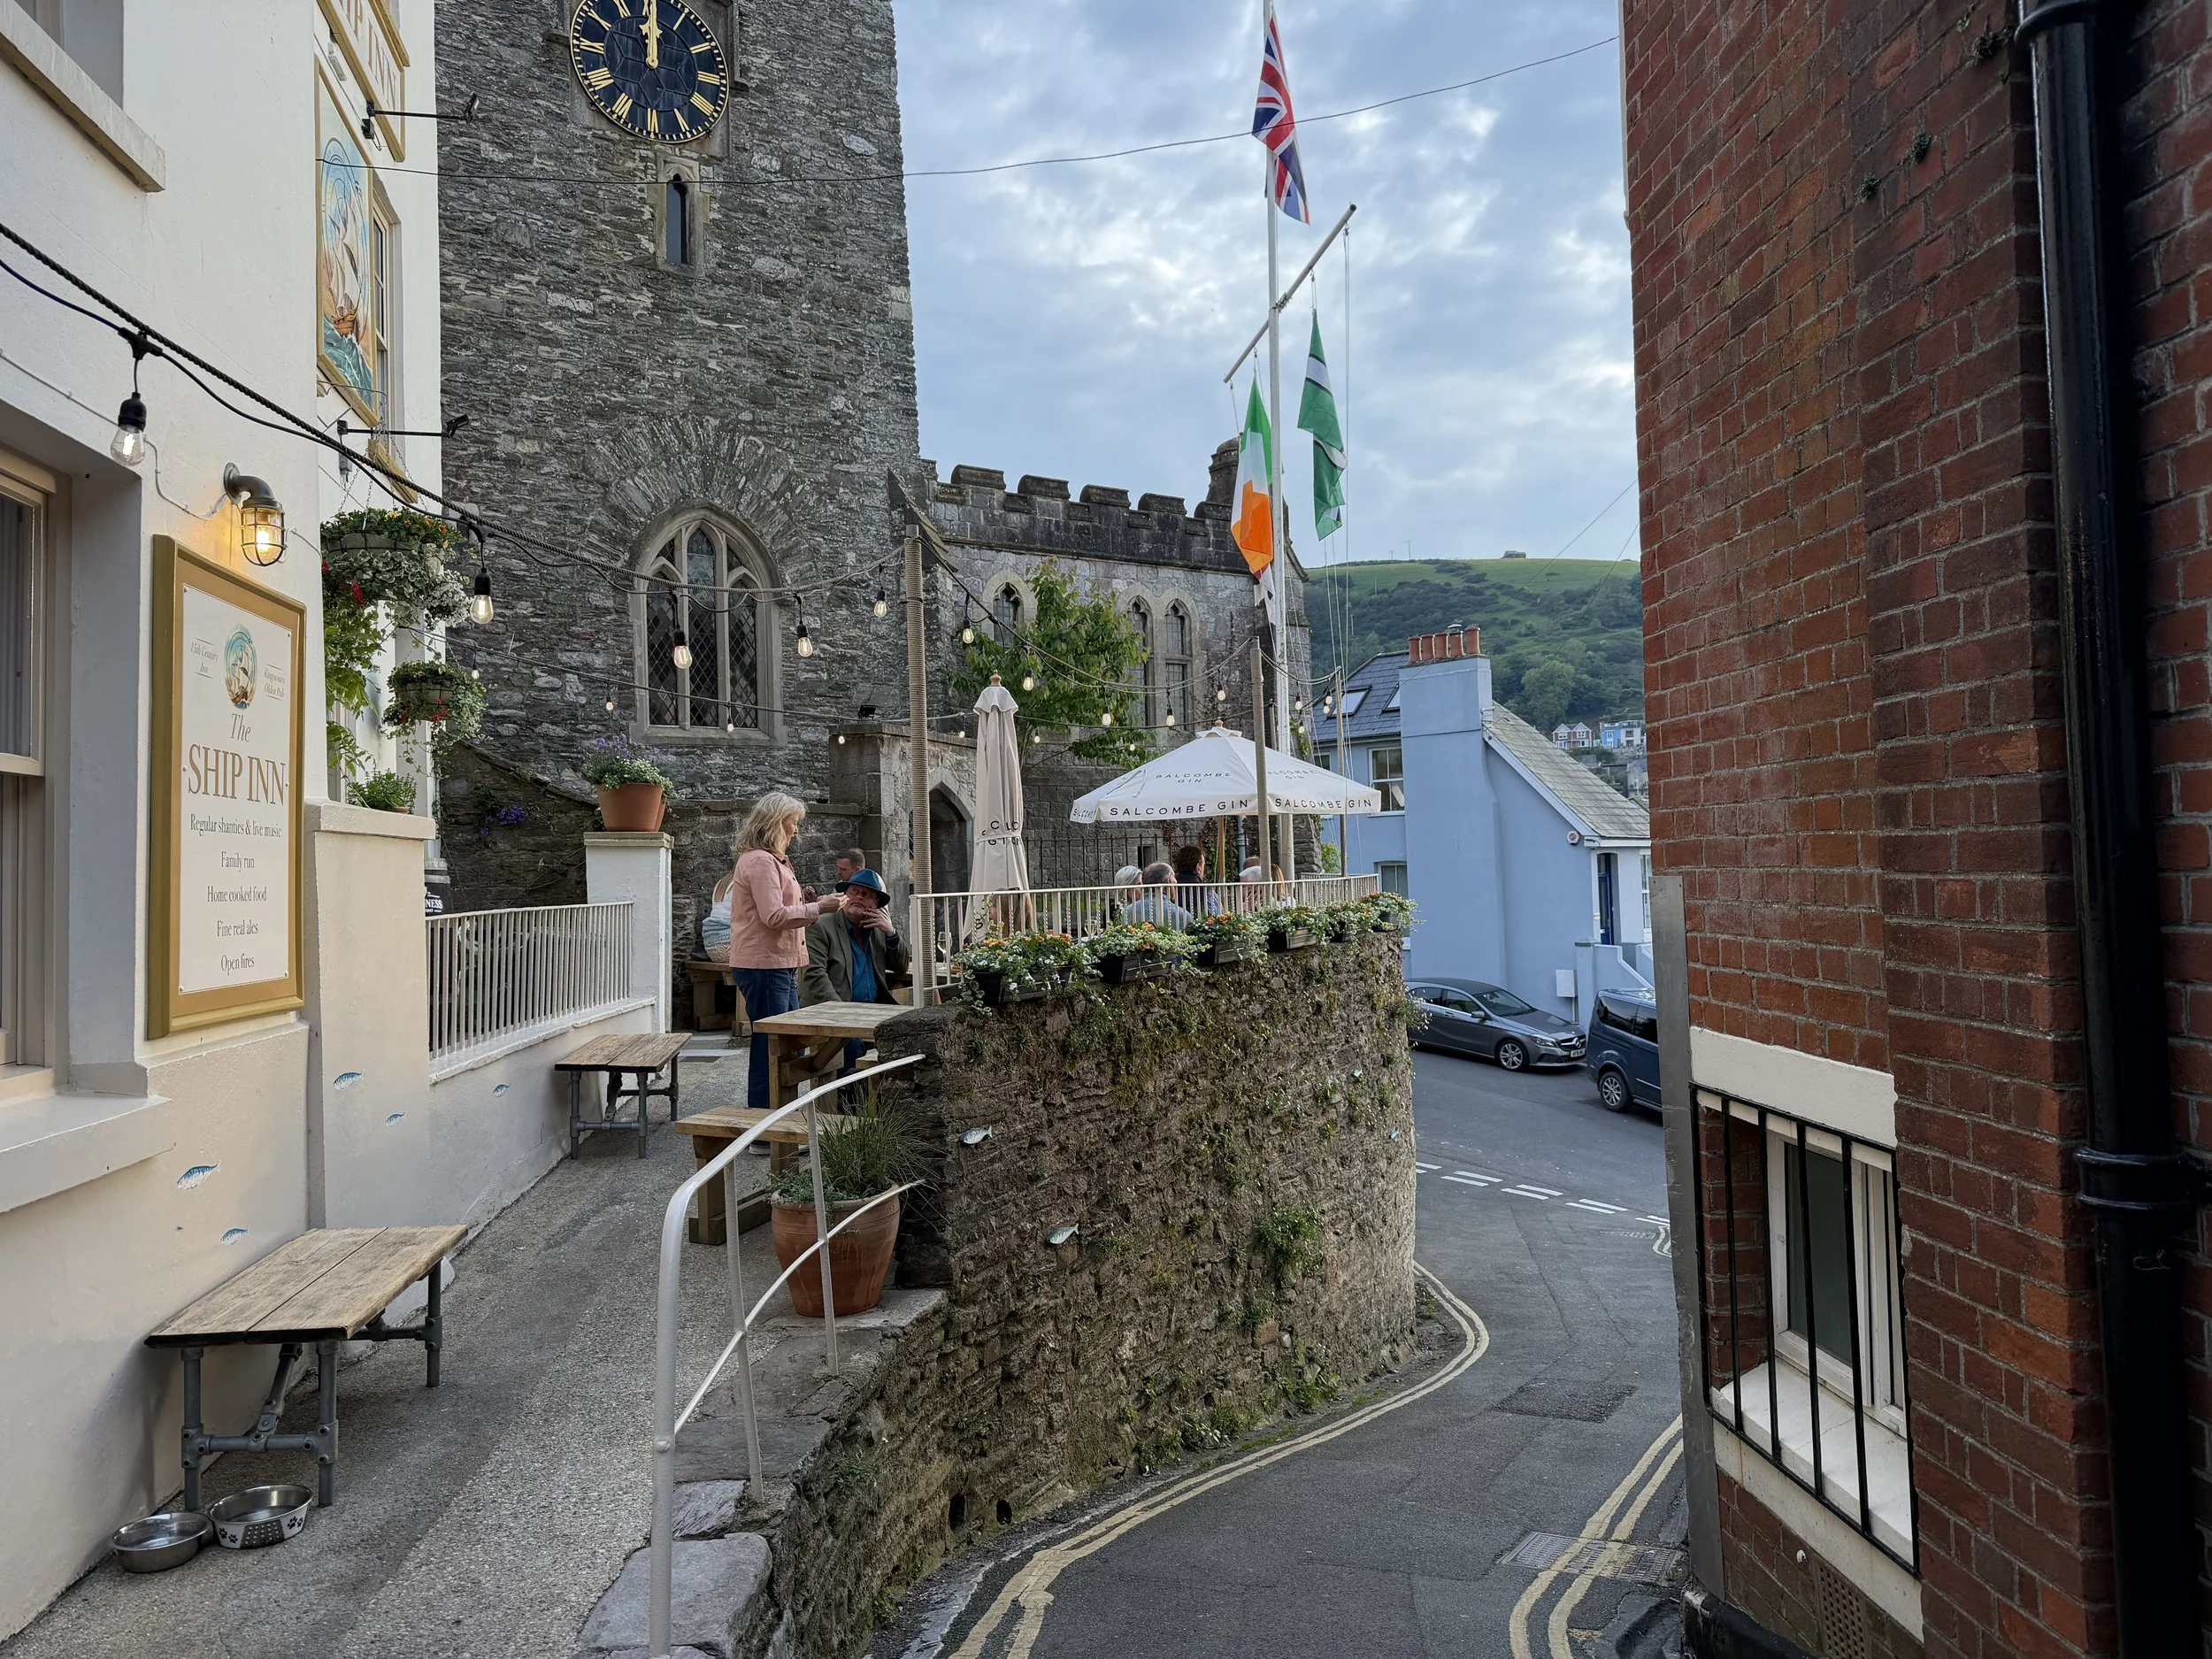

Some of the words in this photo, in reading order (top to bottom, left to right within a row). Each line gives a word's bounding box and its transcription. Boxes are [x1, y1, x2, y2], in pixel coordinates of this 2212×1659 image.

[368, 18, 396, 111] INN
[230, 713, 251, 742] The
[188, 743, 243, 799] SHIP
[247, 756, 286, 806] INN
[1110, 803, 1206, 816] SALCOMBE
[1217, 799, 1248, 810] GIN
[1275, 798, 1341, 809] SALCOMBE
[1348, 799, 1371, 809] GIN
[190, 813, 218, 837] Regular
[218, 817, 245, 835] shanties
[245, 819, 251, 835] &
[252, 820, 264, 836] live
[264, 823, 282, 838] music
[221, 851, 242, 873] Family
[243, 857, 255, 868] run
[207, 886, 228, 902] Home
[228, 886, 252, 902] cooked
[253, 886, 267, 902] food
[425, 899, 443, 910] NESS
[217, 920, 232, 937] Fine
[233, 919, 245, 936] real
[246, 919, 258, 934] ales
[220, 955, 240, 975] Open
[241, 953, 255, 969] fires
